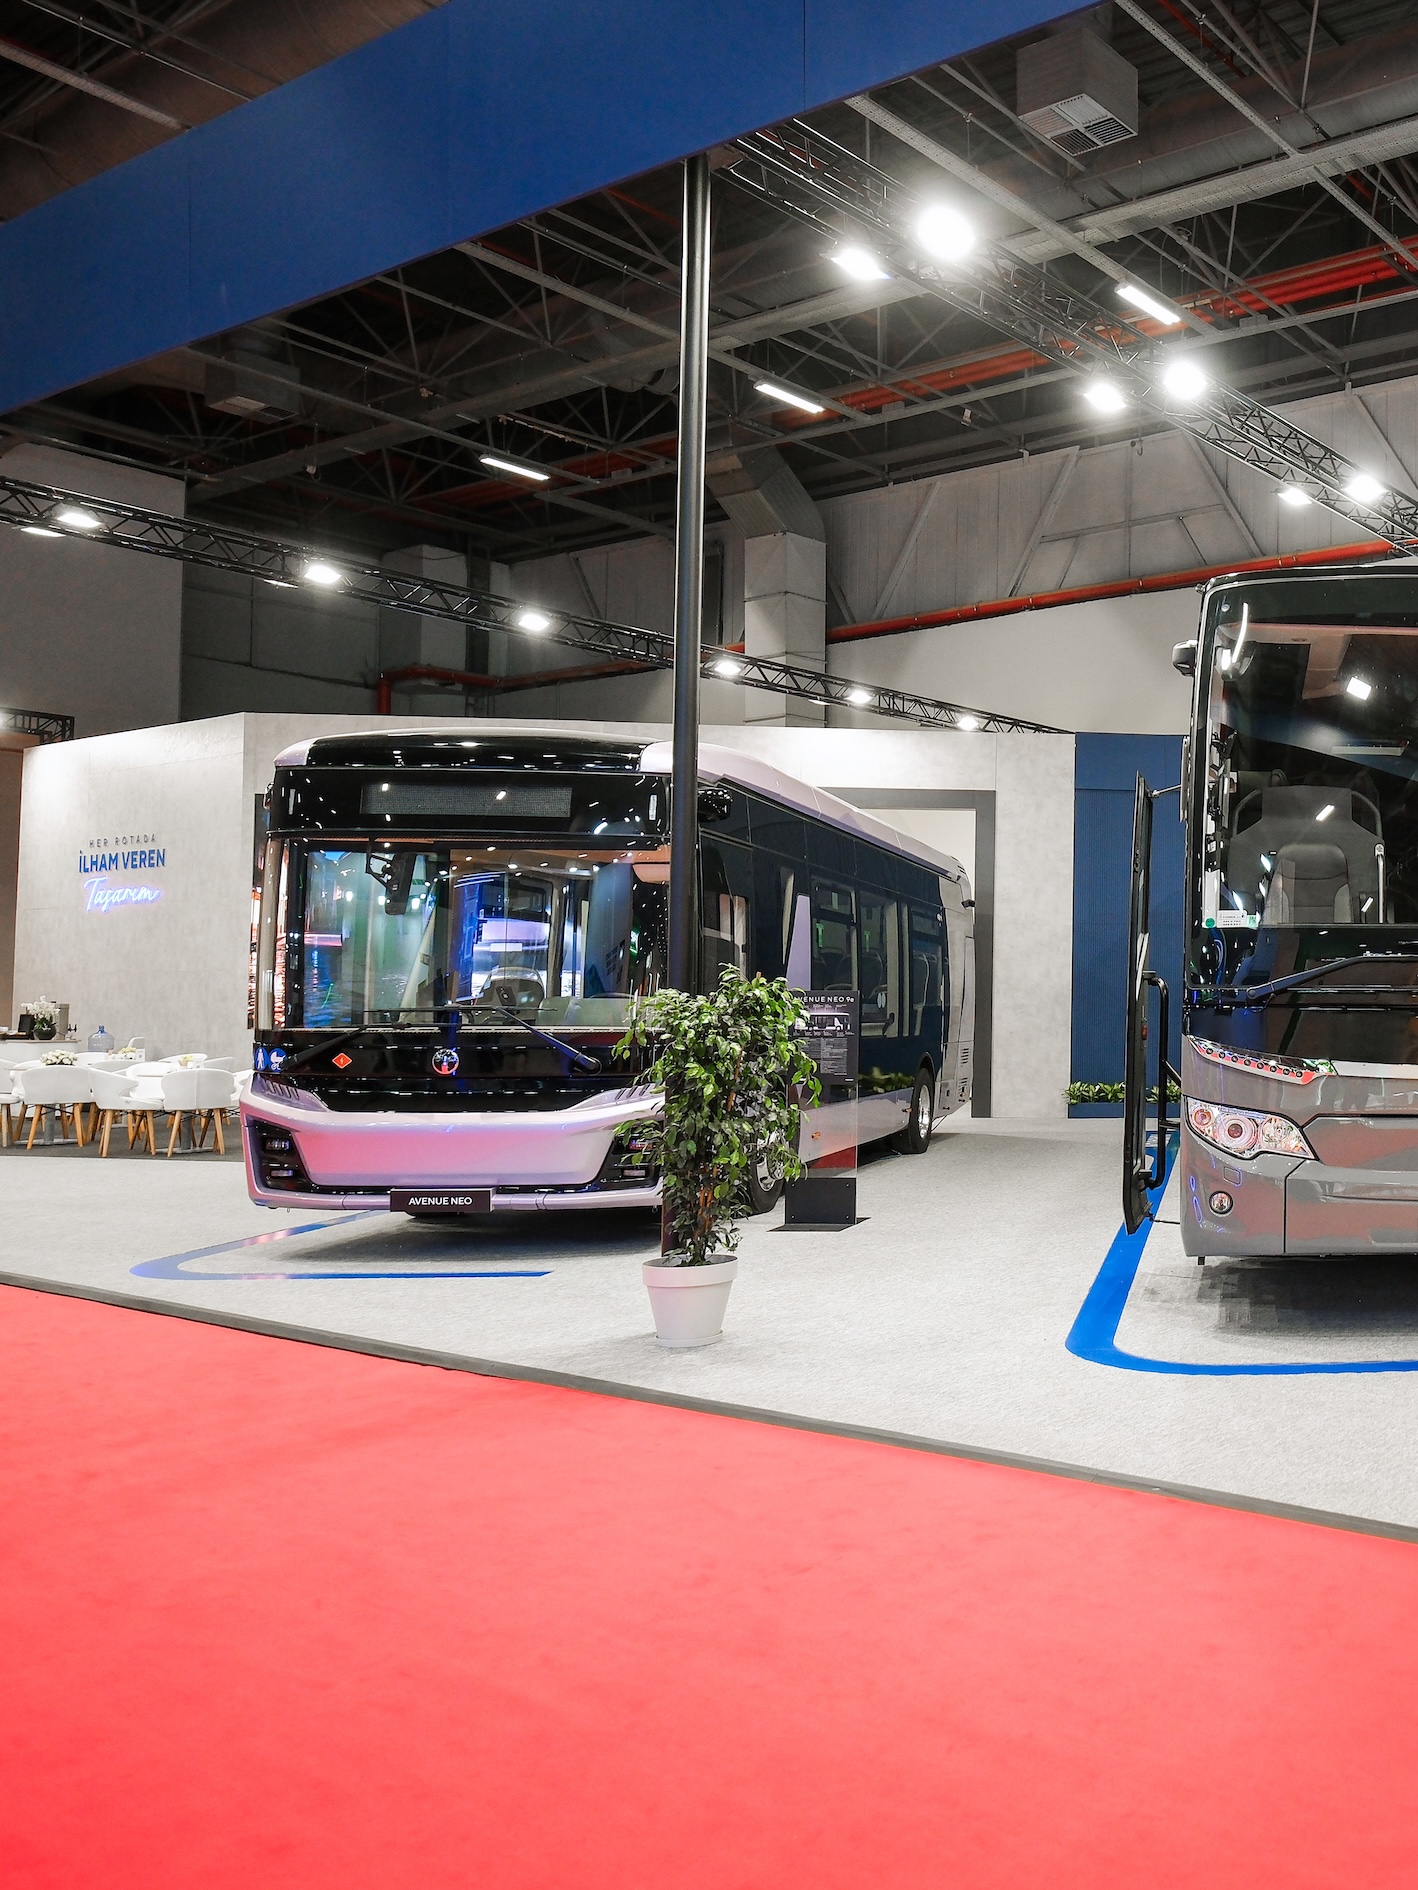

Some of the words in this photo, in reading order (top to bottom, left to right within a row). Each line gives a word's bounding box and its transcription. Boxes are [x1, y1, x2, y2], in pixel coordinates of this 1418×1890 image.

[89, 838, 108, 848] HER
[115, 834, 156, 846] ROTADA
[79, 850, 118, 873] İLHAM
[122, 848, 165, 869] VEREN
[408, 1196, 449, 1206] AVENUE
[450, 1196, 473, 1206] NEO
